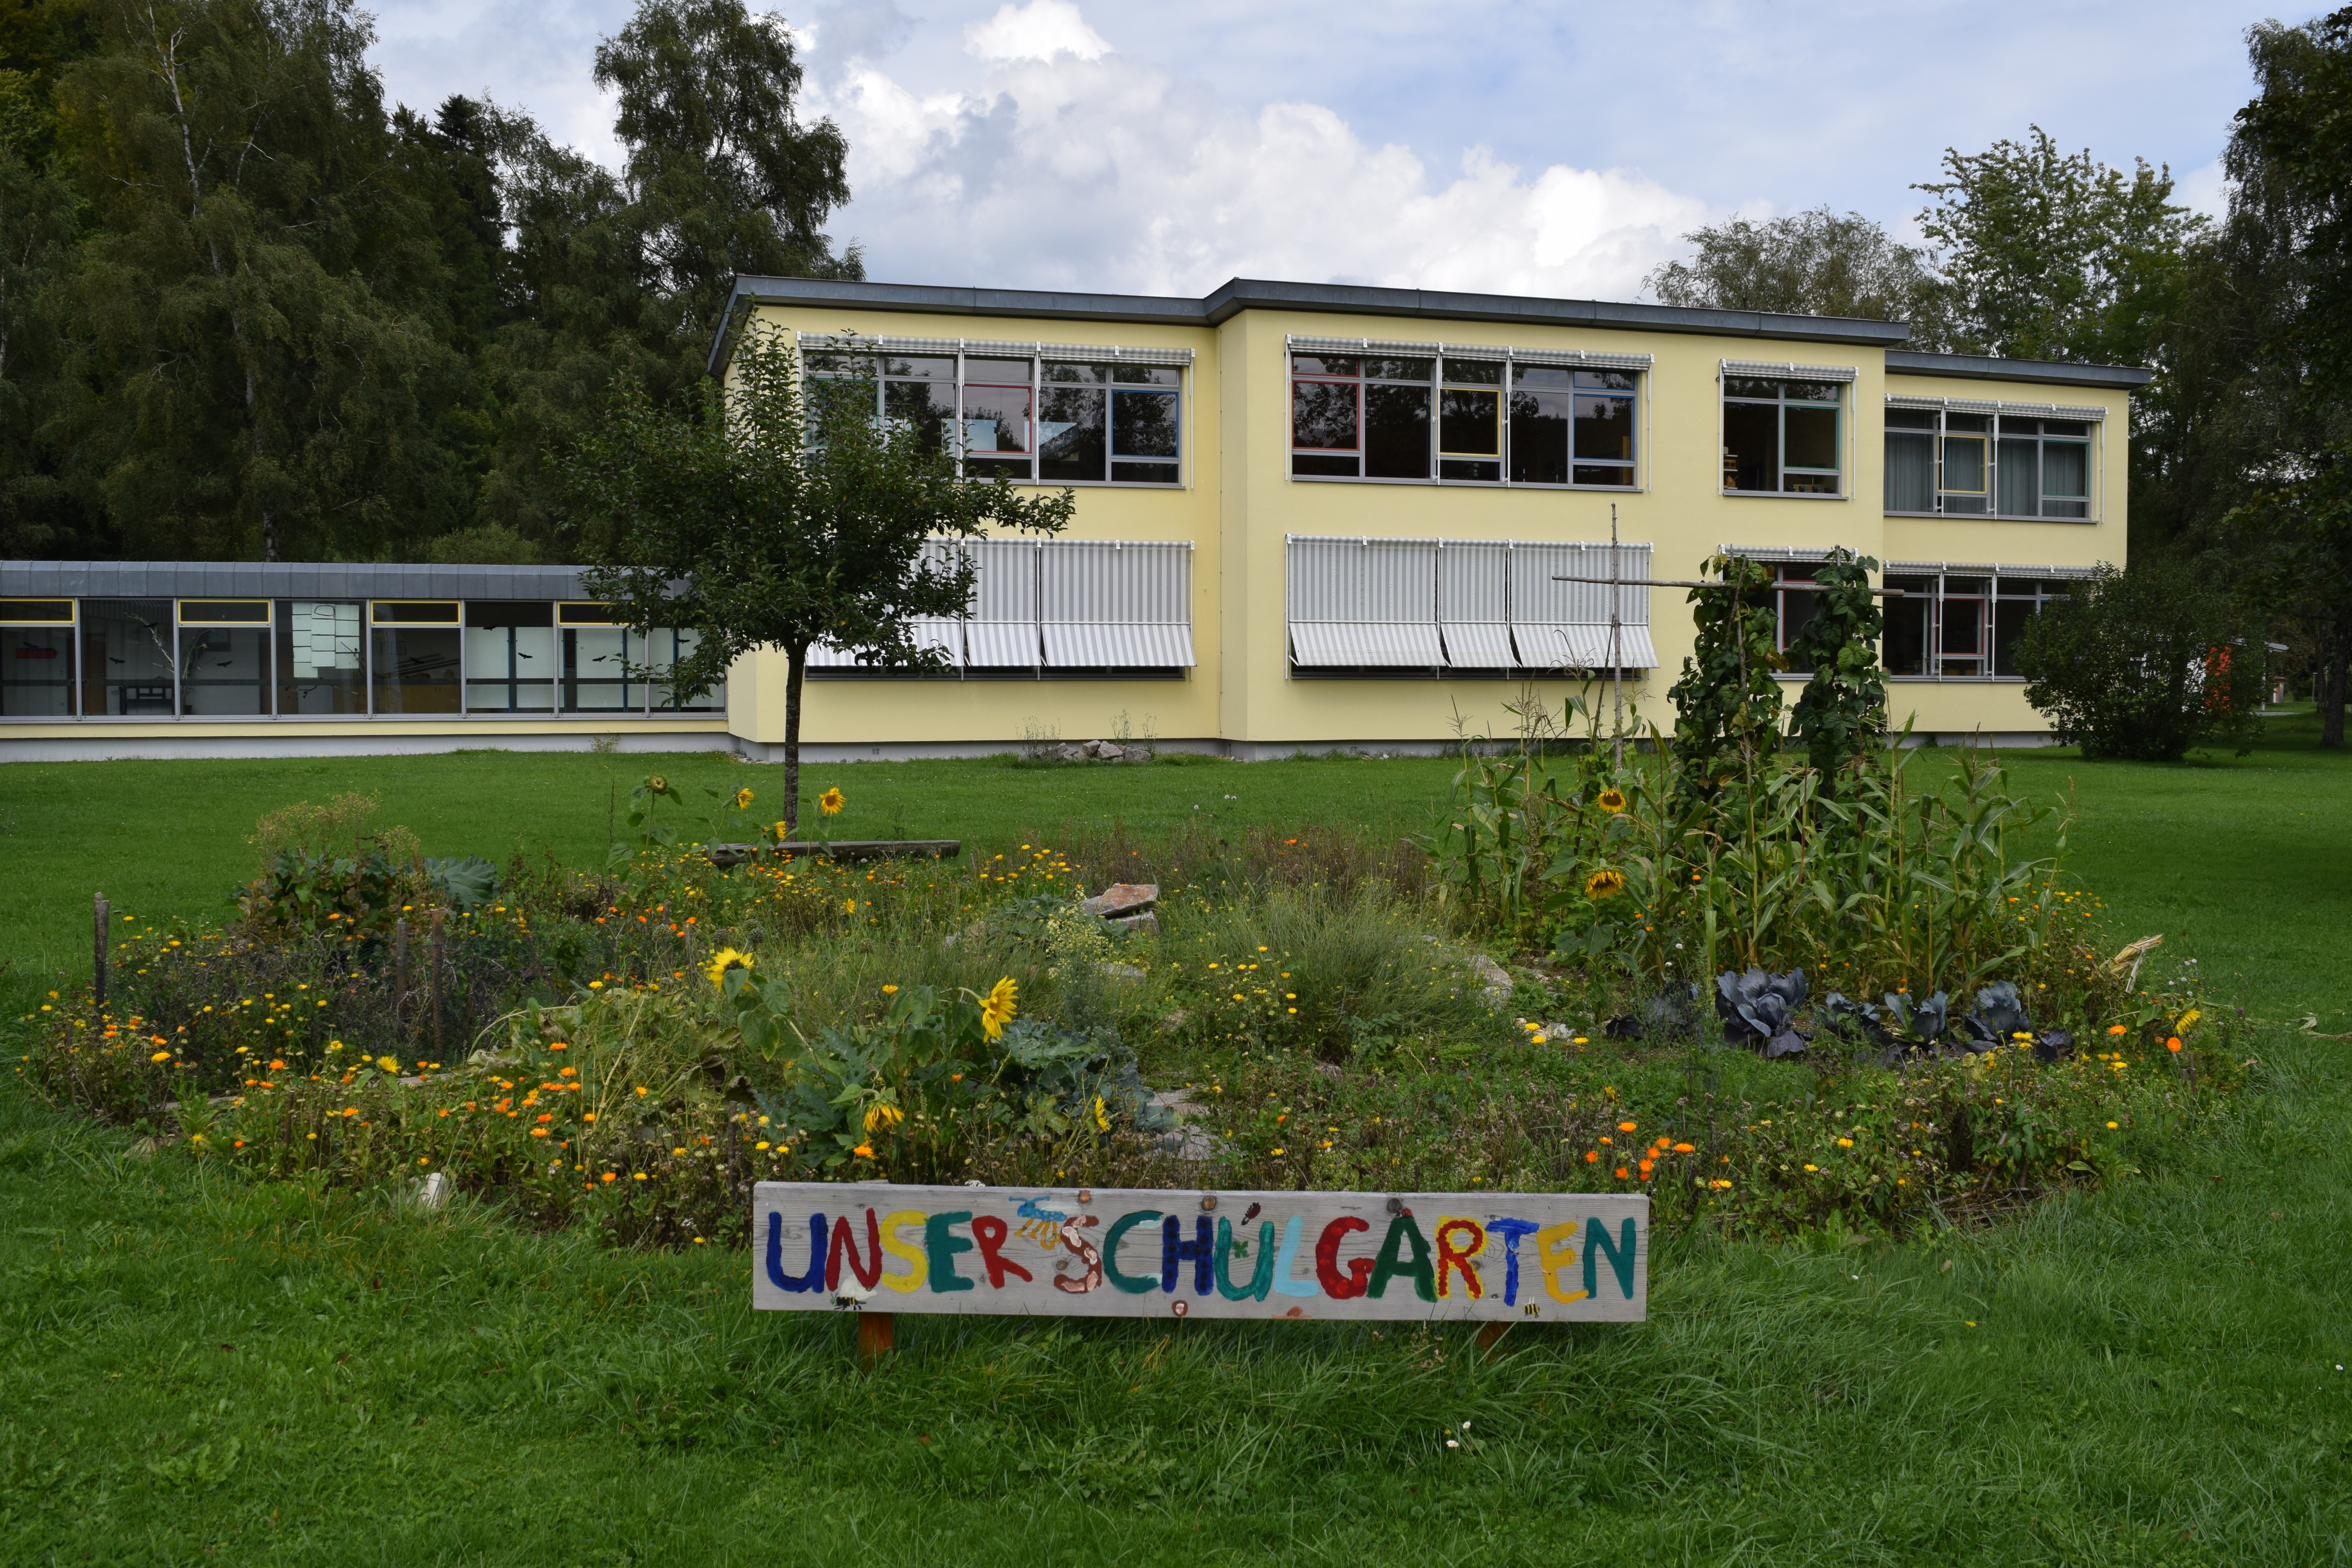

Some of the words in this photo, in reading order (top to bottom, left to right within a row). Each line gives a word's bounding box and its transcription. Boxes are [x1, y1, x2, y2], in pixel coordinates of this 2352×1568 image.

[17, 648, 53, 657] Mensa
[766, 1207, 1033, 1293] UNSER
[1054, 1210, 1637, 1307] SCHULGARTEN
